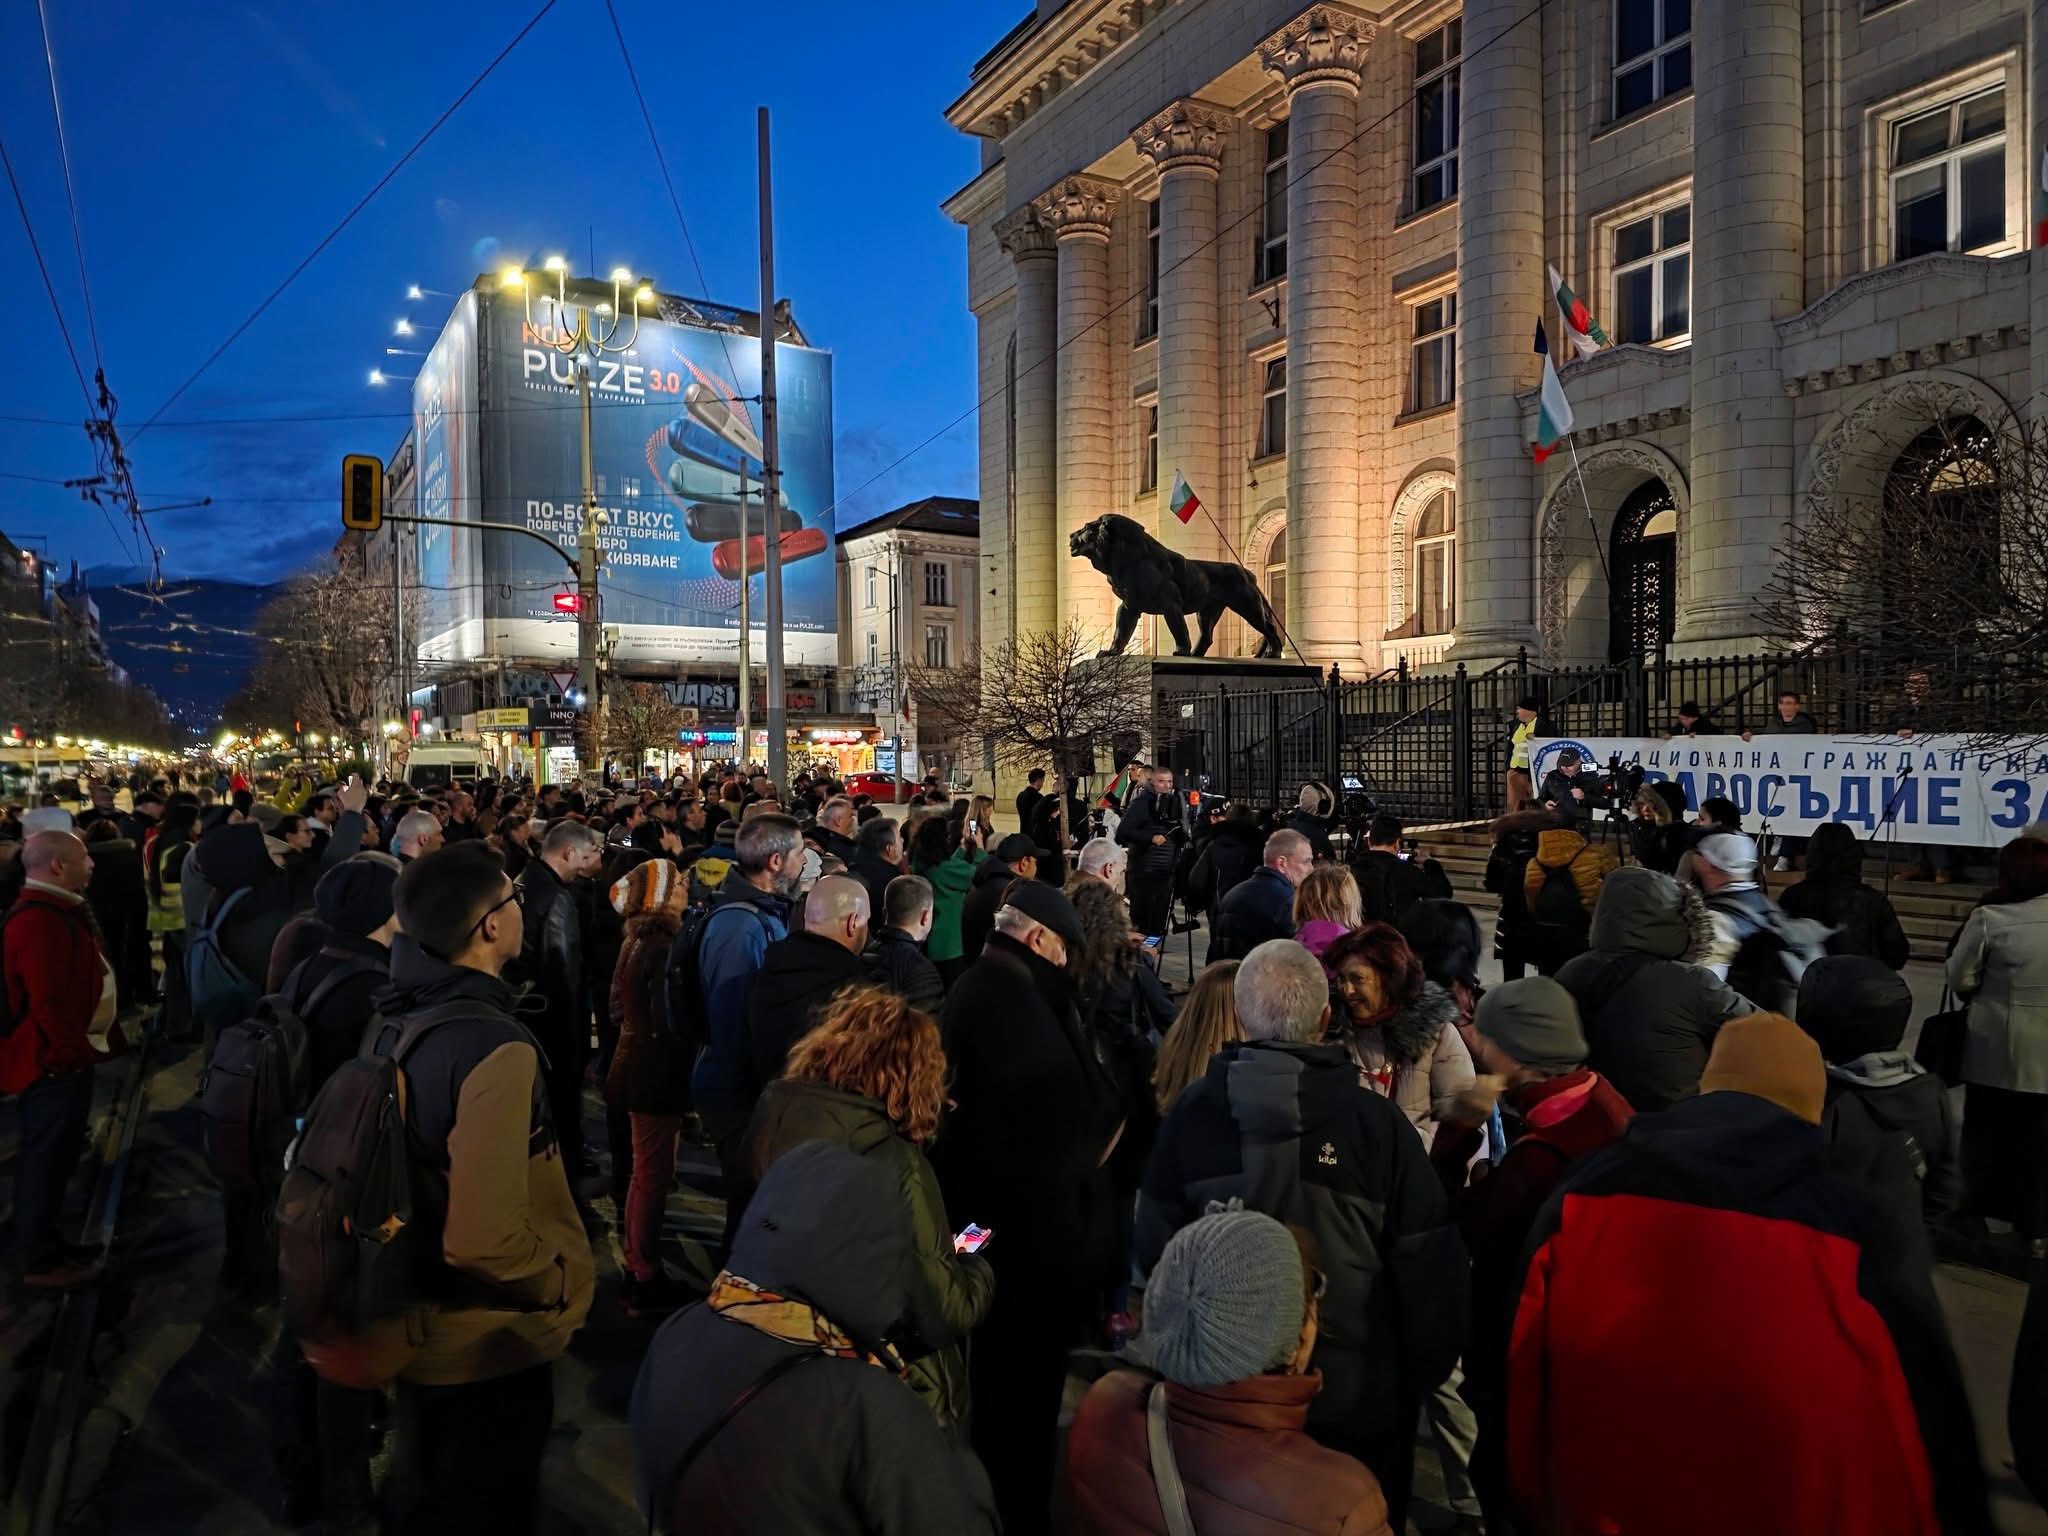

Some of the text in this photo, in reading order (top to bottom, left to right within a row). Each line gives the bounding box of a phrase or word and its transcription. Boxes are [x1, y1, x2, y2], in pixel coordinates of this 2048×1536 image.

[649, 369, 680, 394] 3.0
[526, 519, 574, 533] ПОВЕЧЕ
[627, 509, 674, 530] ВКУС
[1318, 1154, 1337, 1165] kilpi
